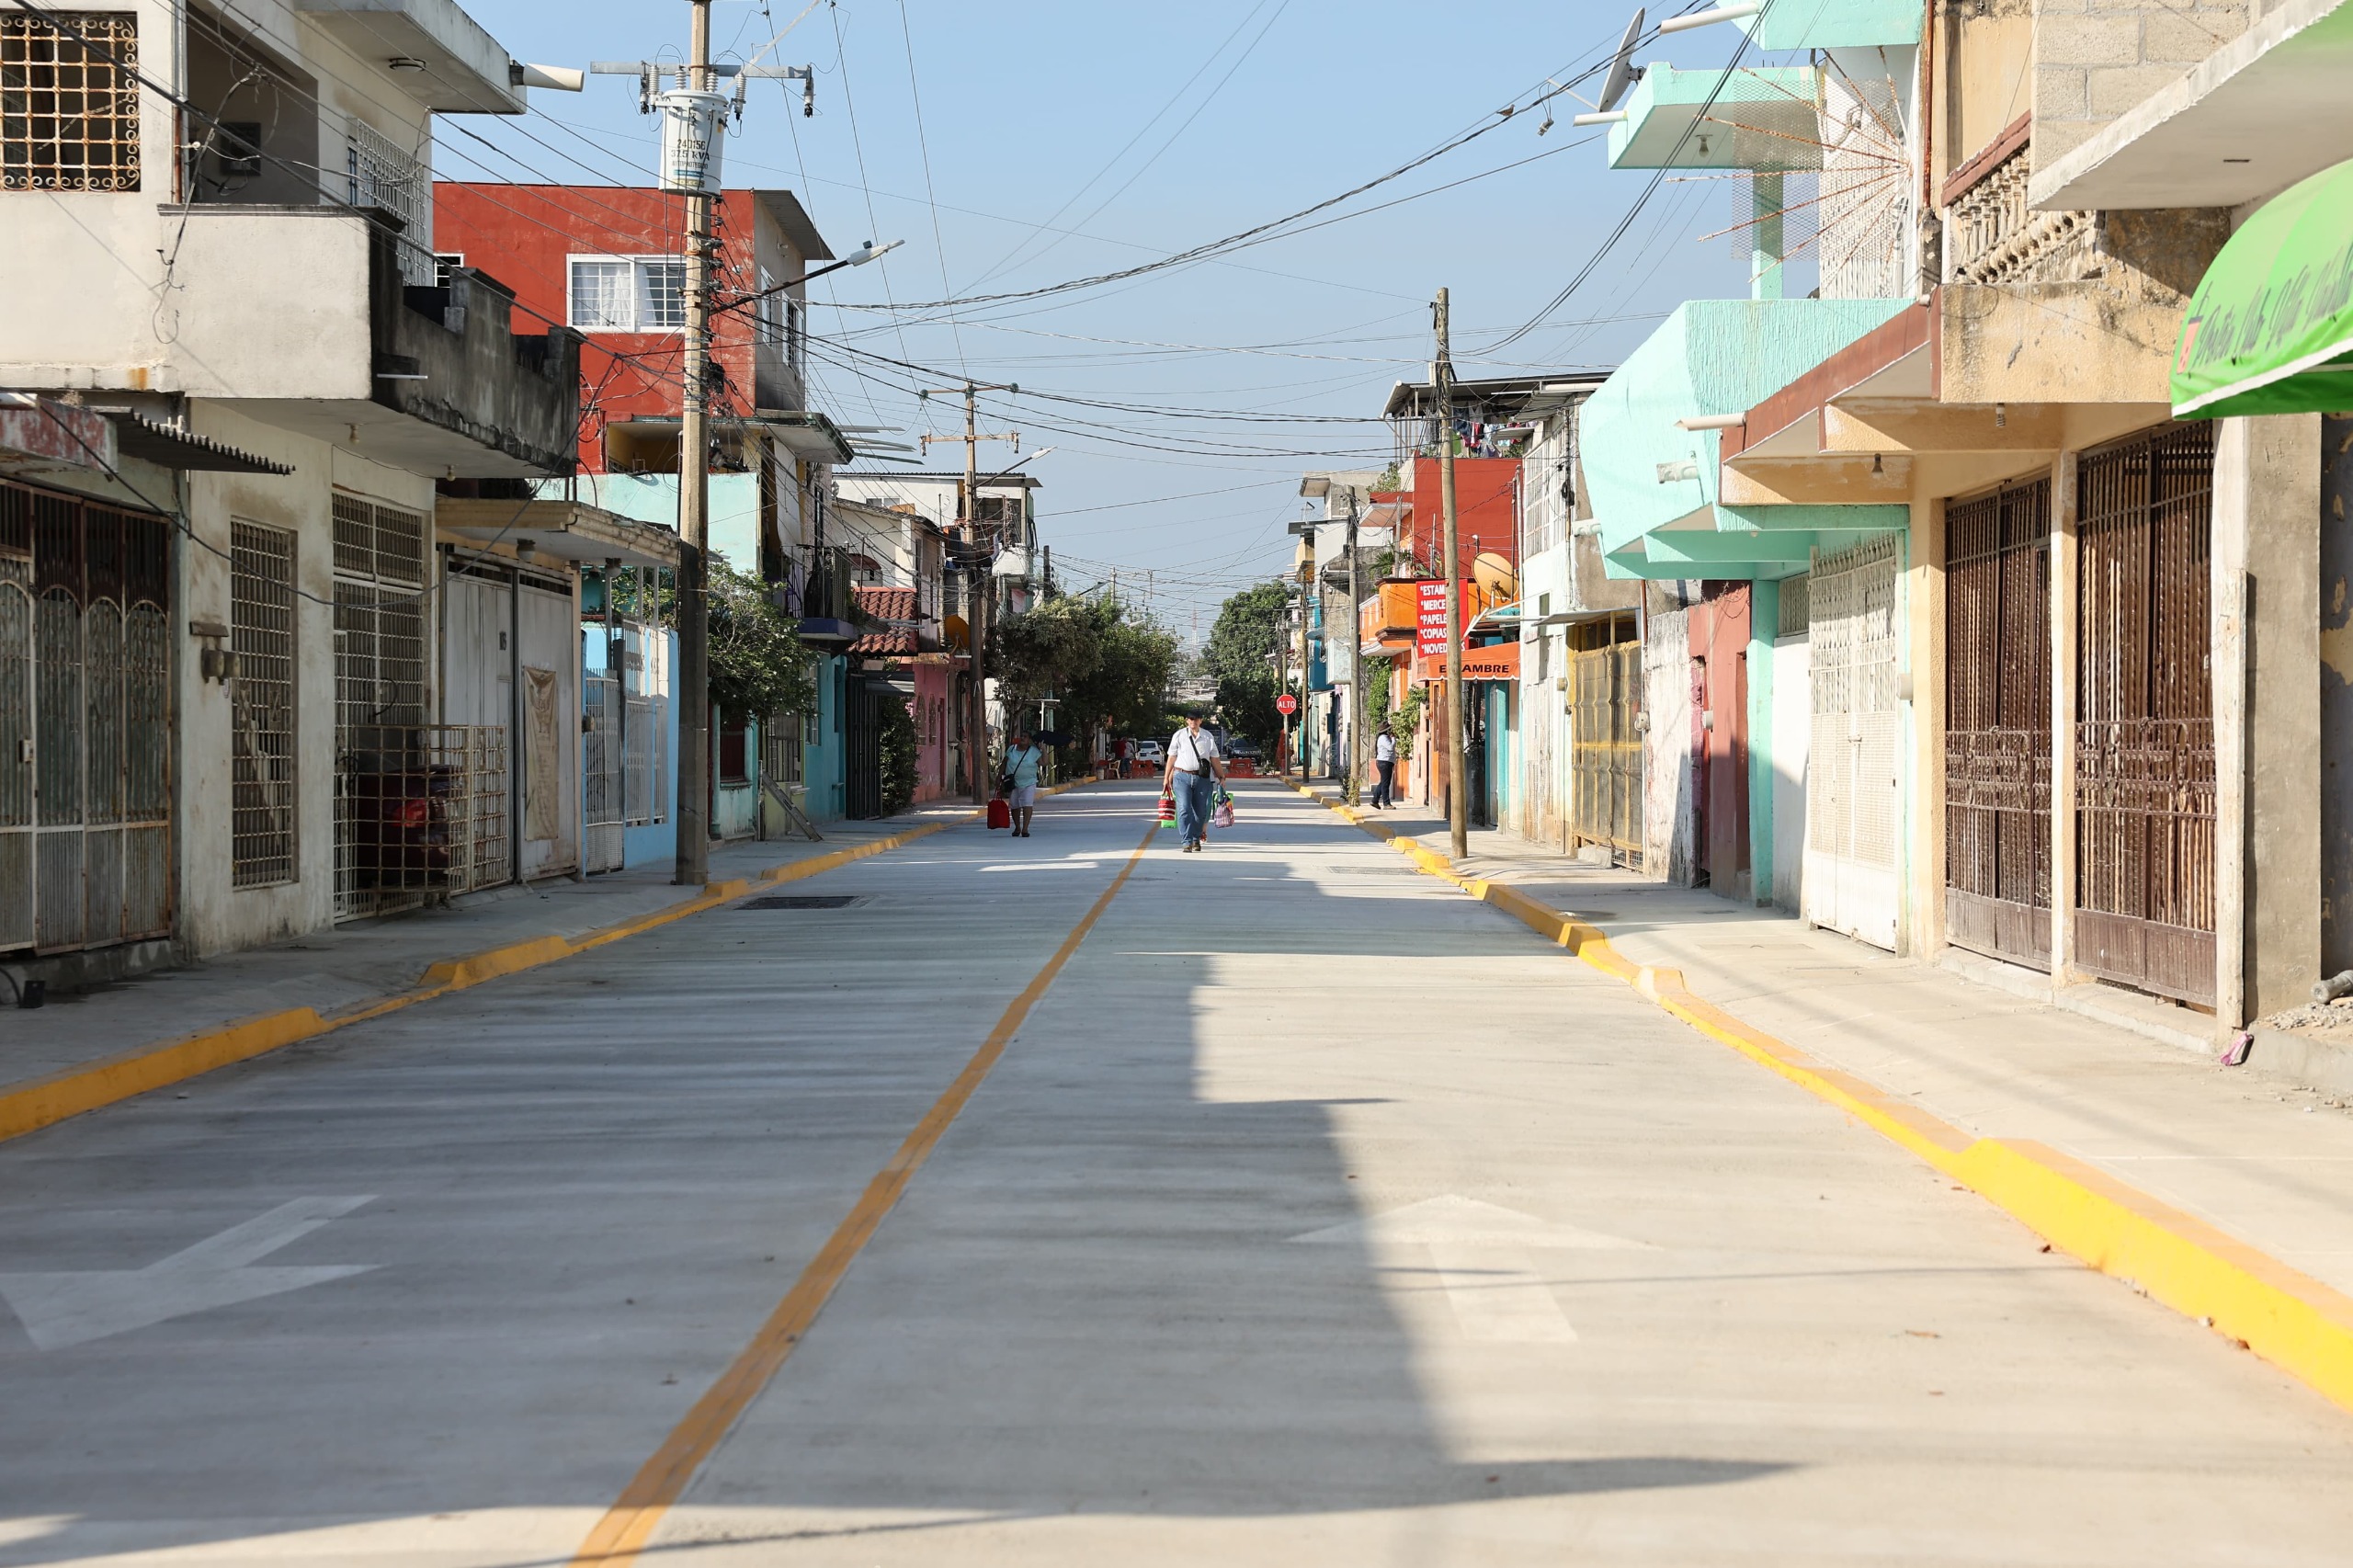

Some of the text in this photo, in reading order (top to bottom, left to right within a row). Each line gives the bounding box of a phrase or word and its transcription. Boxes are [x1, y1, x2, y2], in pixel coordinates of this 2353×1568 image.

[1420, 585, 1446, 596] ESTAM
[1421, 599, 1446, 610] MERCE
[1420, 614, 1447, 625] PAPELE
[1439, 665, 1509, 673] EAMBRE
[1278, 700, 1295, 709] ALTO
